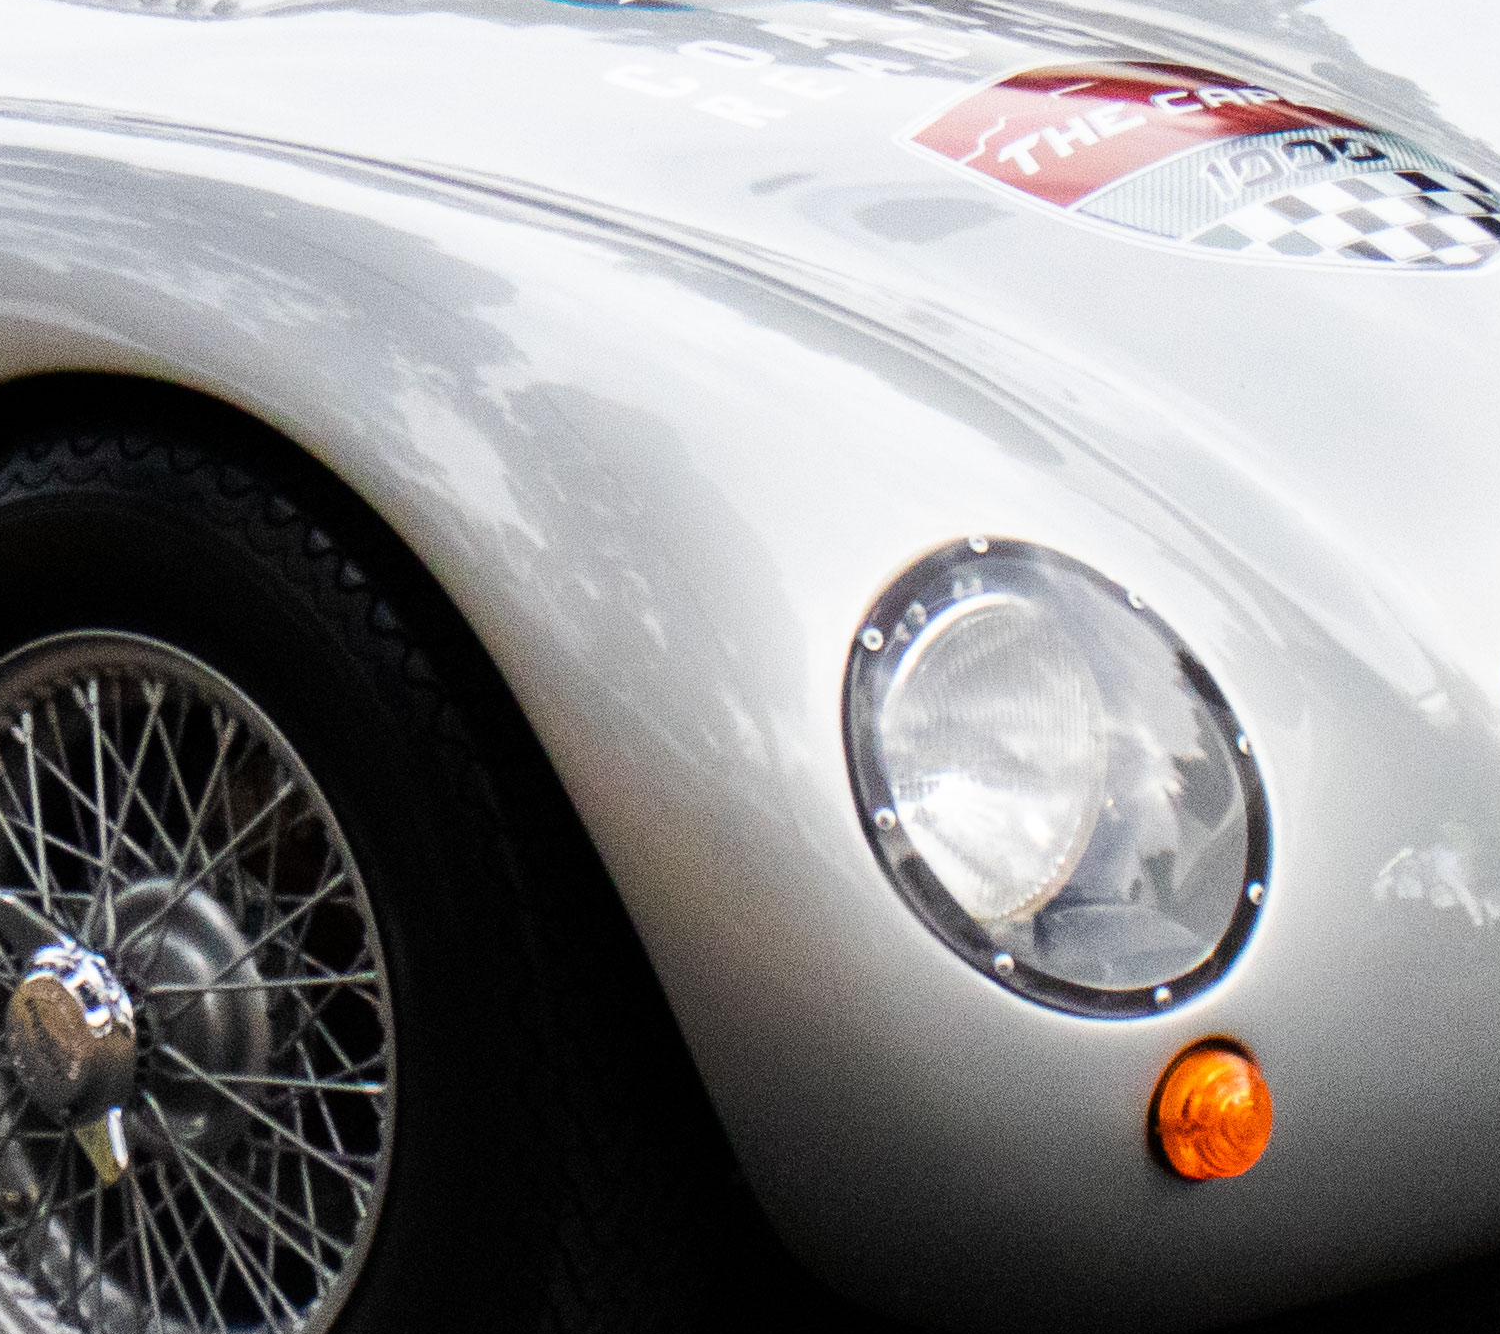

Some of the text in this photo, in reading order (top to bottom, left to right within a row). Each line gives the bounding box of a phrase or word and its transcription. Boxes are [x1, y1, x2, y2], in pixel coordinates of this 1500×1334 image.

[996, 86, 1295, 176] THE CAP
[1198, 136, 1388, 201] 1000
